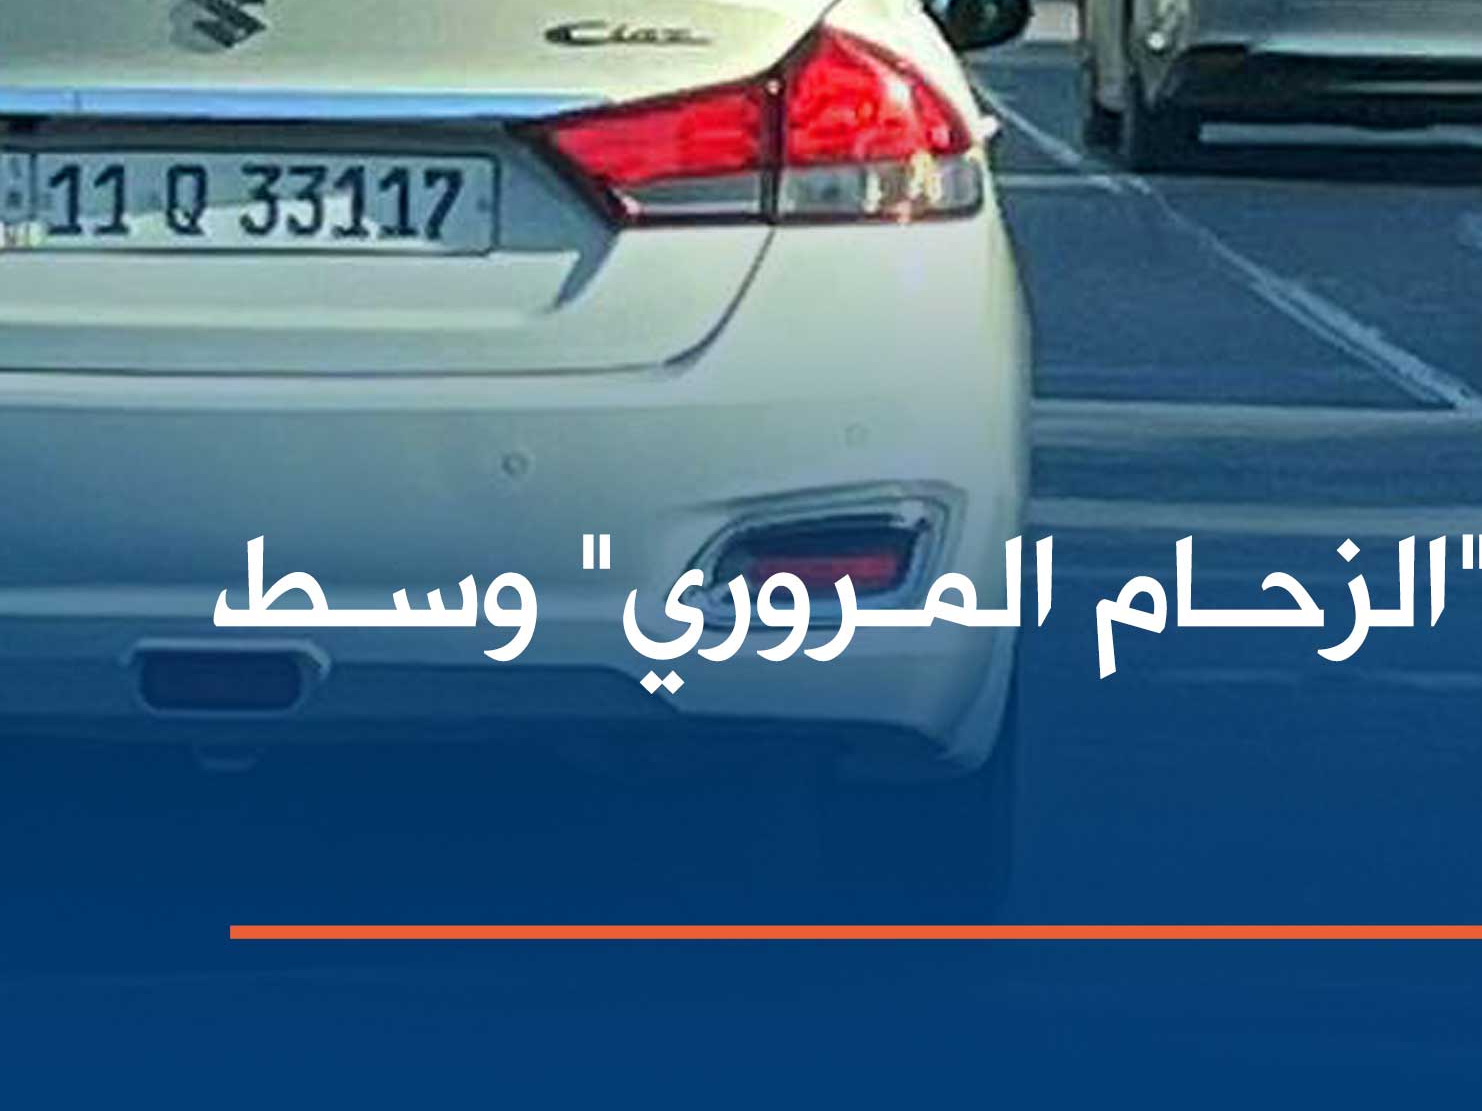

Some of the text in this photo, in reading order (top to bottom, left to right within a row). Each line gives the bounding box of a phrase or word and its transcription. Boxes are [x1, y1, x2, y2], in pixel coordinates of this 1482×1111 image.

[48, 162, 130, 237] 11
[166, 164, 208, 236] Q
[239, 162, 463, 240] 33117
